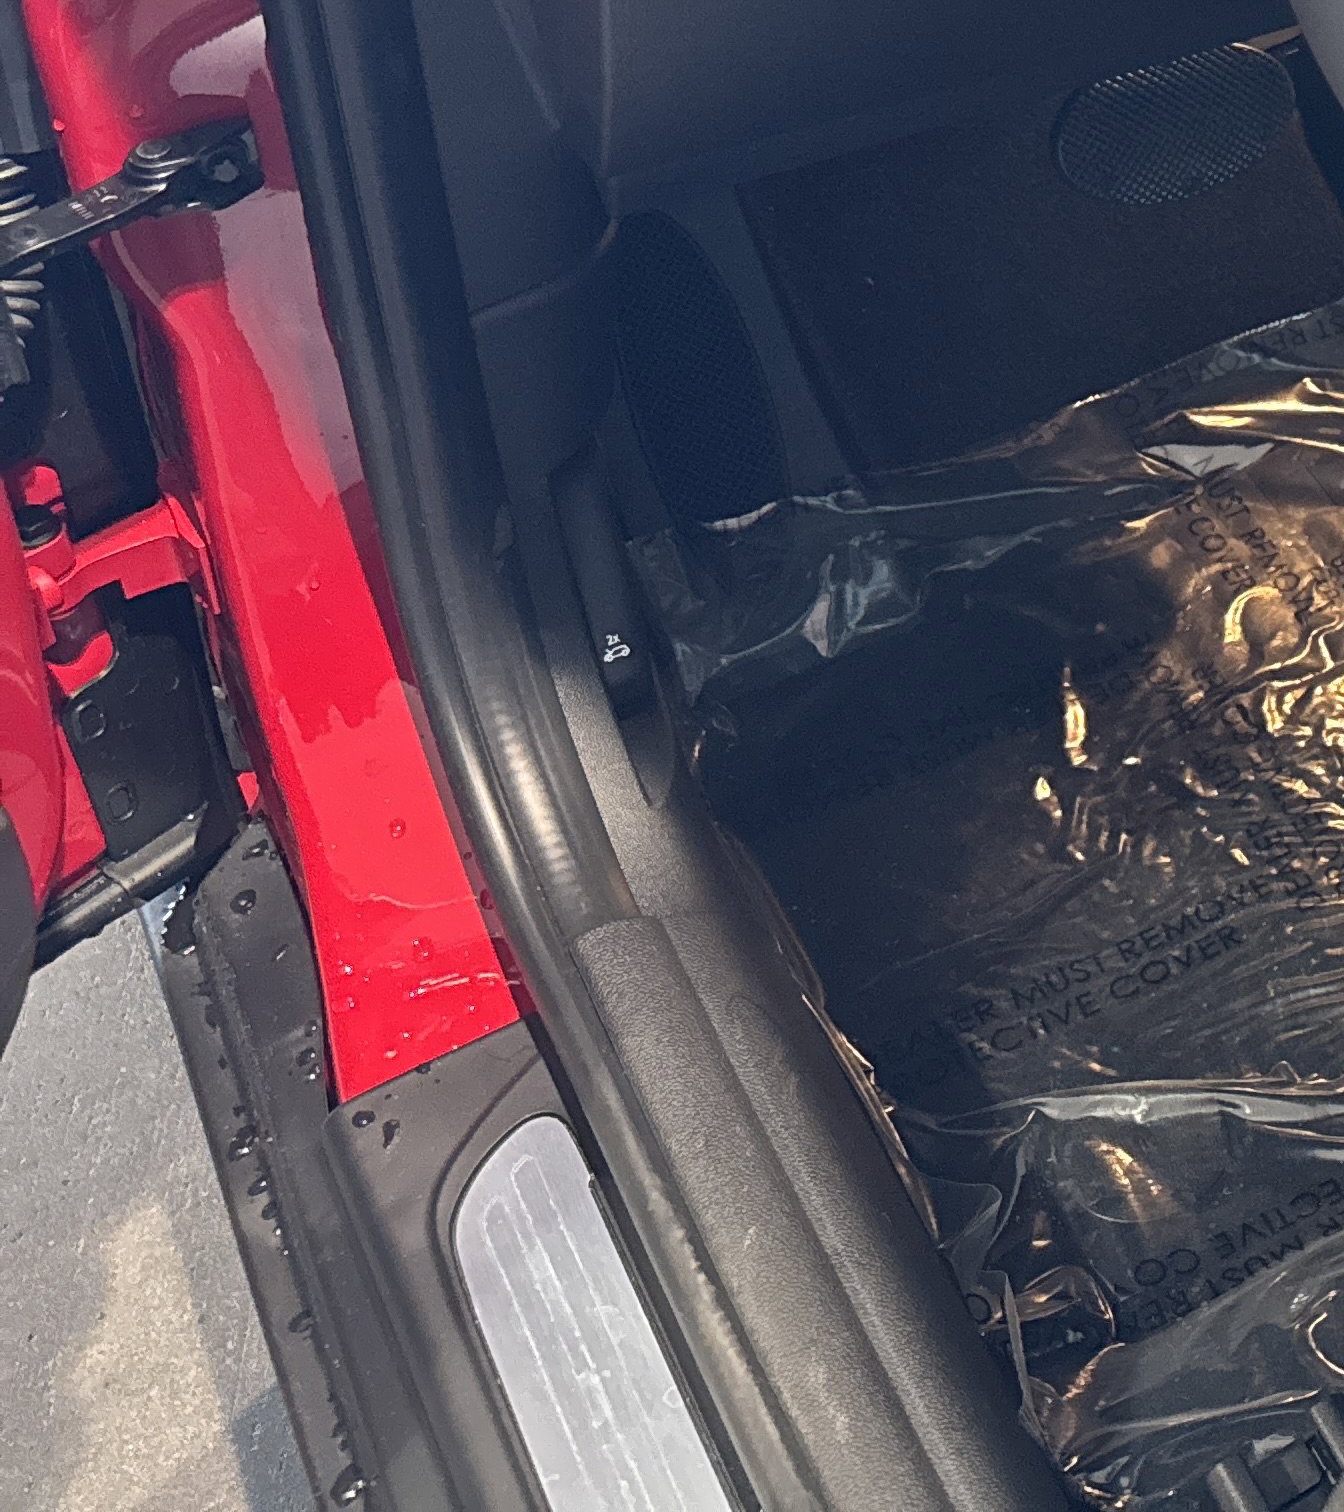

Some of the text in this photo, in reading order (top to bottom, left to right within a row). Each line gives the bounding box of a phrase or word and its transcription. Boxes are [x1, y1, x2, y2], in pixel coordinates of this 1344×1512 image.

[606, 633, 621, 646] 2x
[1008, 955, 1107, 1011] MUST
[1109, 924, 1244, 1001] COVER
[1199, 1235, 1305, 1301] MUST
